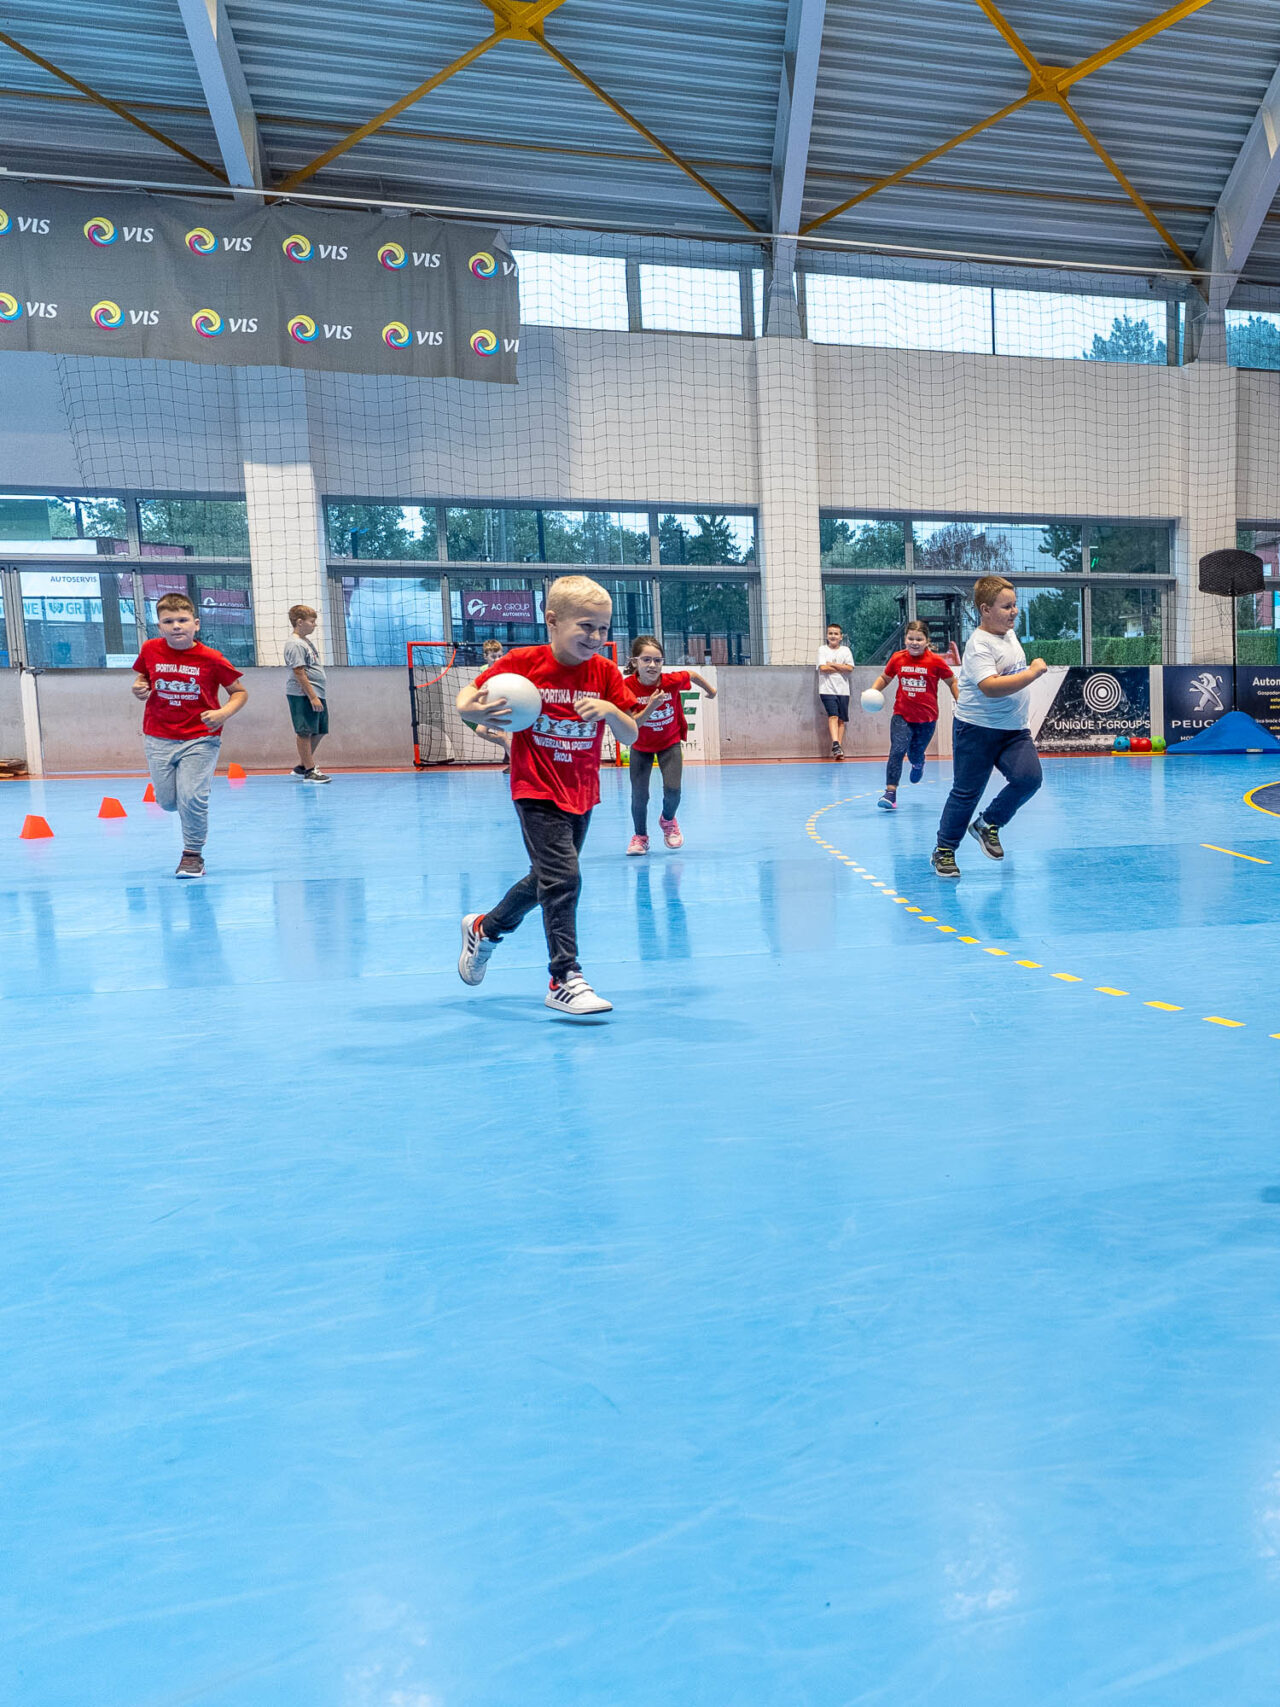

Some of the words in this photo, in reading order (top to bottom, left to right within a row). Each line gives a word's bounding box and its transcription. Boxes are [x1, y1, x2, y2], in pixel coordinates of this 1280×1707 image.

[17, 216, 50, 235] VIS
[123, 226, 154, 243] VIS
[223, 237, 252, 252] VIS
[318, 244, 348, 261] VIS
[412, 251, 441, 268] VIS
[26, 301, 58, 319] VIS
[129, 309, 159, 325] VIS
[228, 318, 258, 333] VIS
[323, 324, 352, 340] VIS
[416, 331, 443, 346] VIS
[50, 575, 97, 583] AUTOSERVIS
[1054, 720, 1094, 730] UNIQUE
[1171, 720, 1219, 729] PEUG
